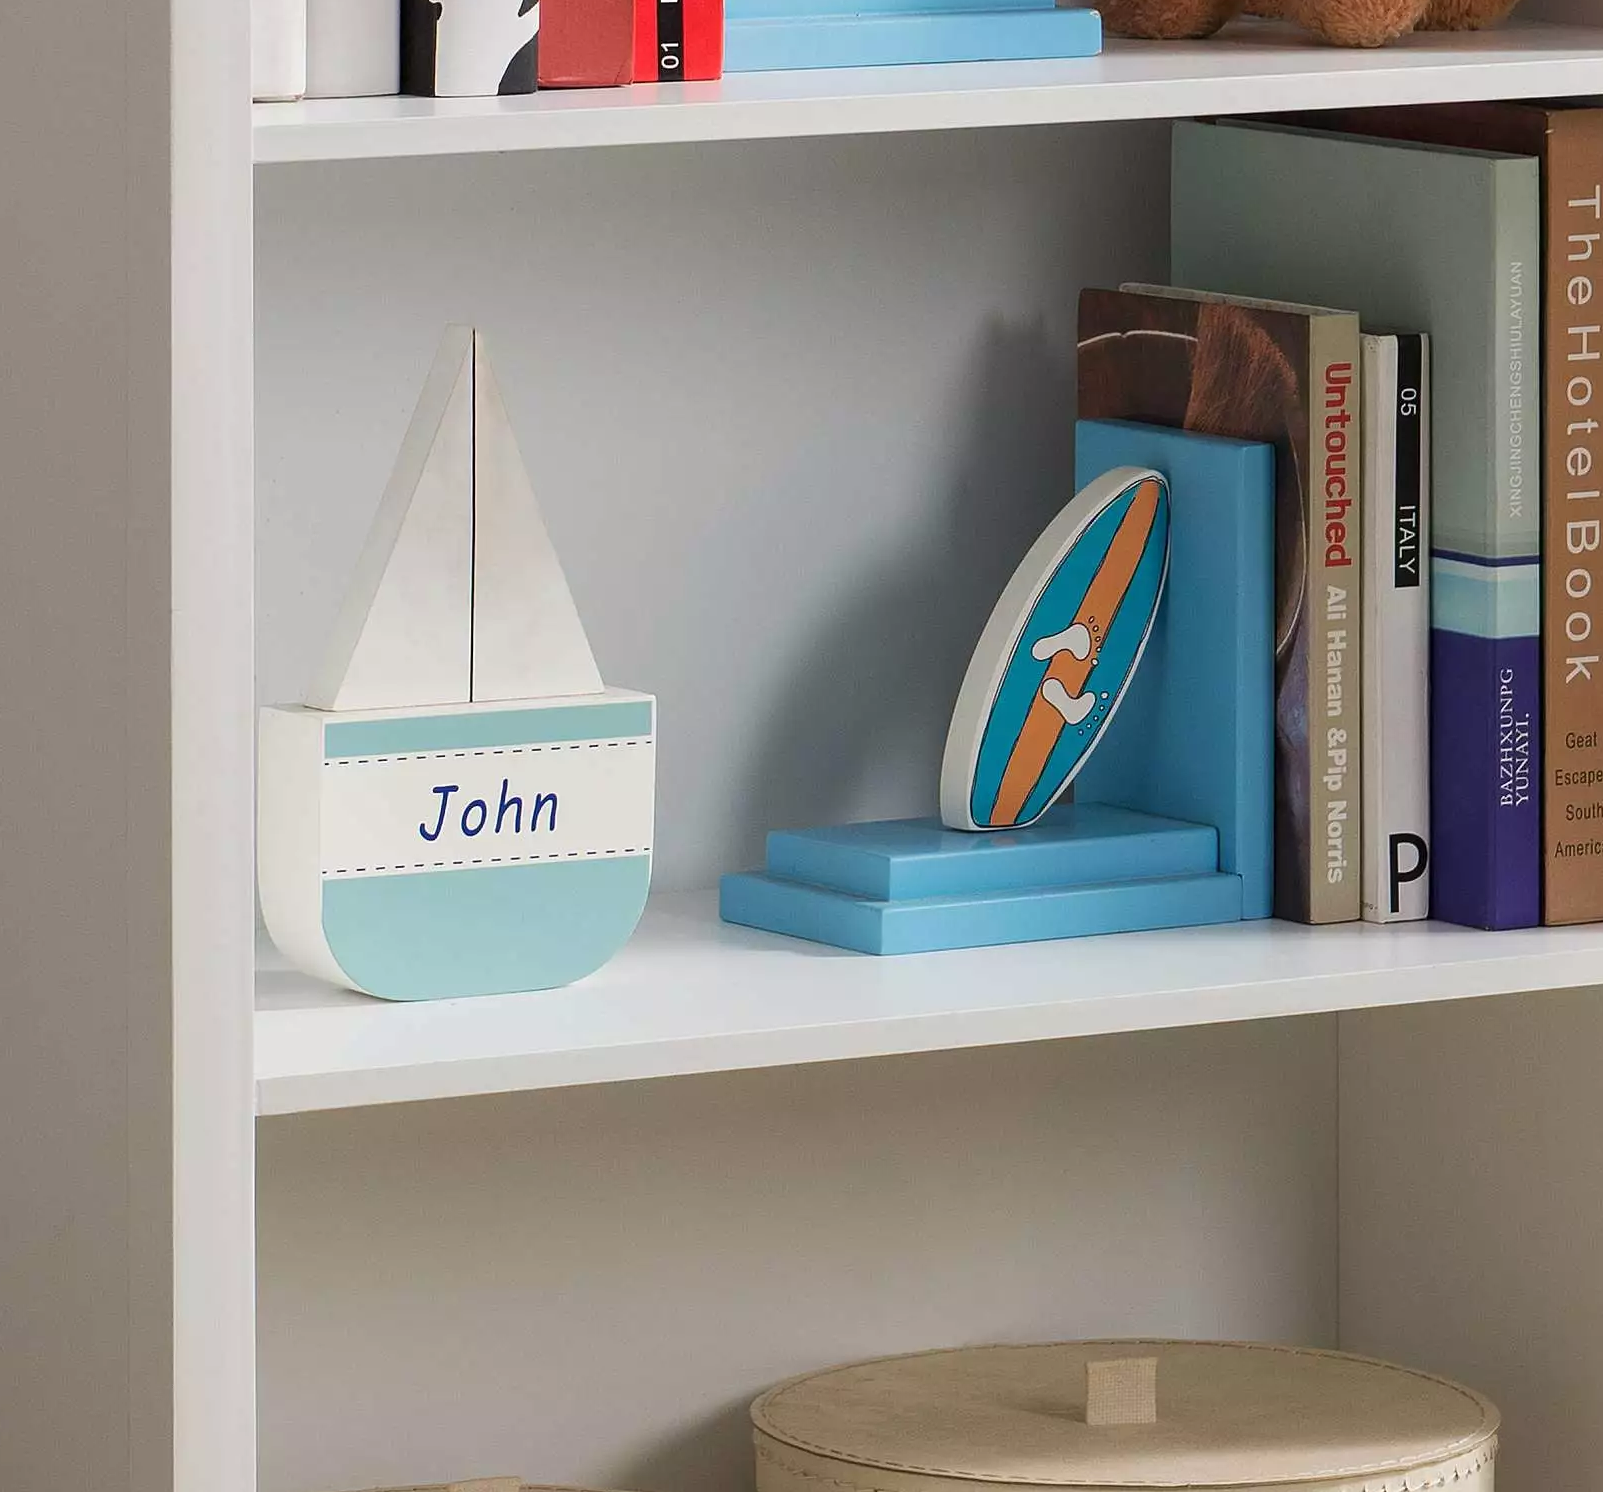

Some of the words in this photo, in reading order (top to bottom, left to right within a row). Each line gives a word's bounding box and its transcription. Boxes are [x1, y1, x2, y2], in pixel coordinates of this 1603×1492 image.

[660, 42, 680, 69] 01
[1400, 388, 1417, 416] 05
[1323, 362, 1352, 568] Untouched
[1399, 505, 1416, 574] ITALY
[1327, 585, 1347, 619] Ali
[1327, 630, 1347, 717] Hanan
[1565, 732, 1598, 749] Geat
[418, 777, 560, 842] John
[1327, 800, 1347, 884] Norris
[1388, 831, 1429, 914] P
